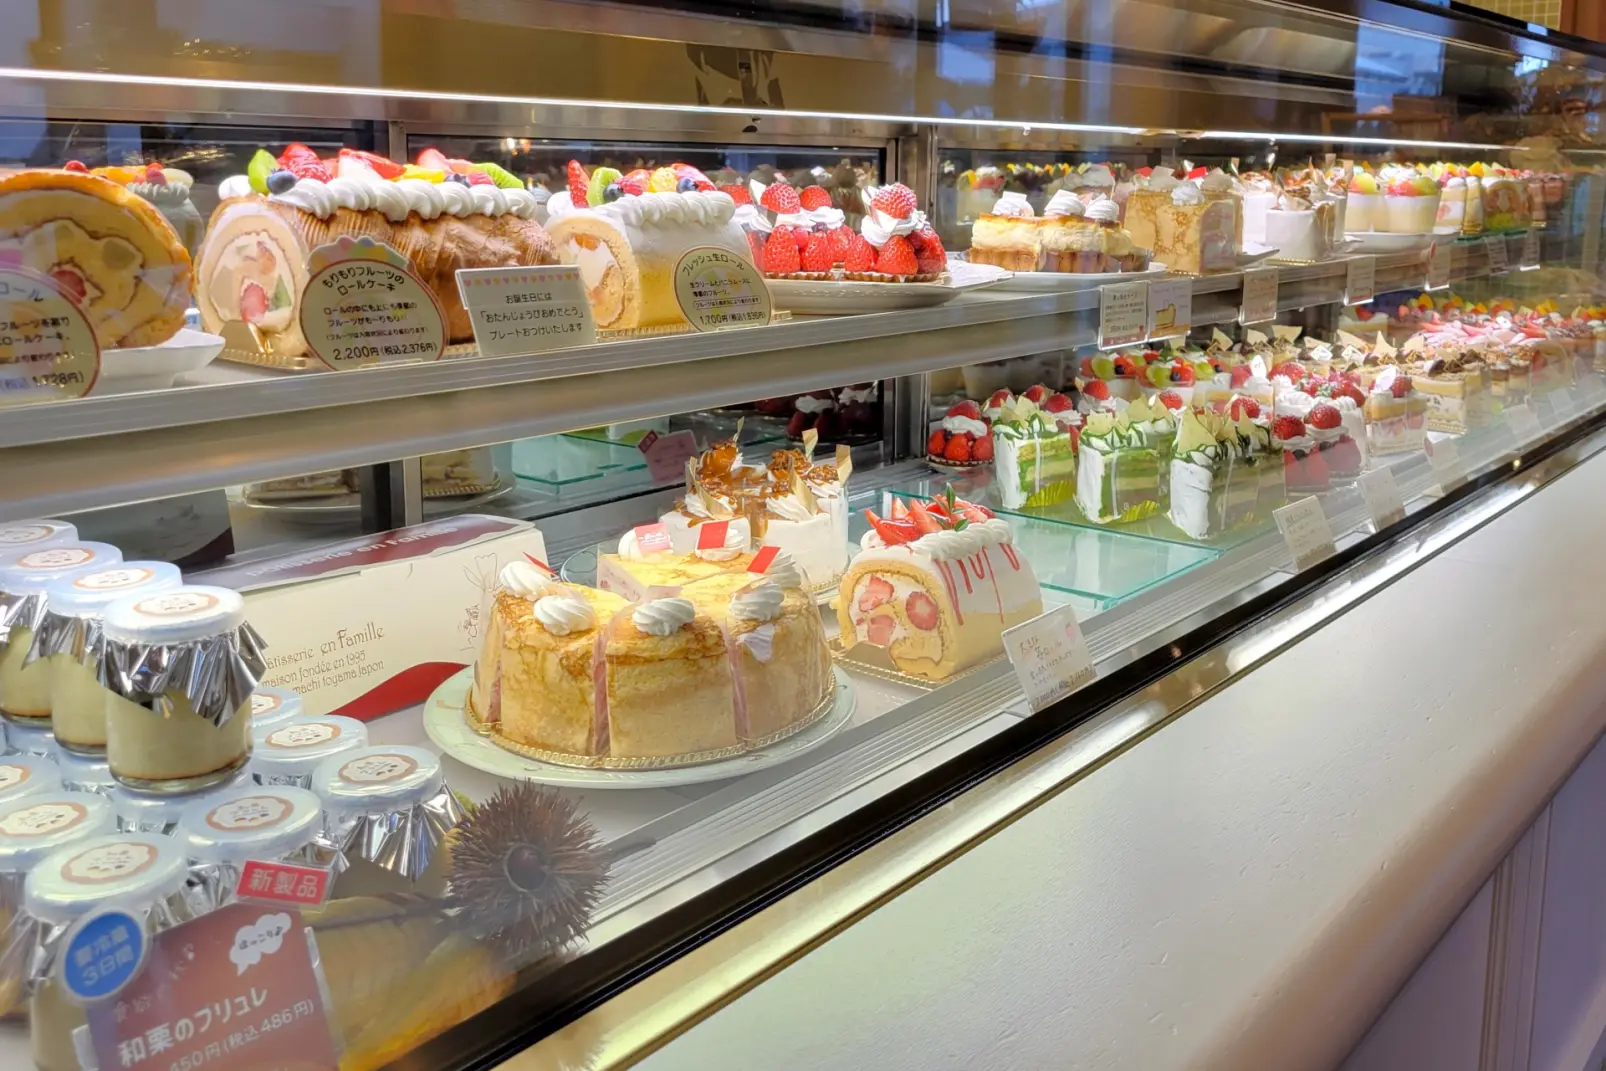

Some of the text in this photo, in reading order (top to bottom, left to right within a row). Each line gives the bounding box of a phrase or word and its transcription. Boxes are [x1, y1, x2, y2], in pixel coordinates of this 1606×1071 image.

[682, 252, 745, 276] フレッシュ生ロール
[322, 266, 405, 288] もりもりフルーツの
[337, 280, 396, 296] ロールケーキ
[505, 292, 553, 304] お誕生日には
[480, 306, 584, 323] 「おたんじょうびおめでとう」
[490, 322, 583, 340] プレートおつけいたします
[266, 621, 385, 670] âtisserie en Famille
[261, 671, 298, 688] maison
[299, 660, 332, 682] fondée
[248, 867, 319, 899] 新製品
